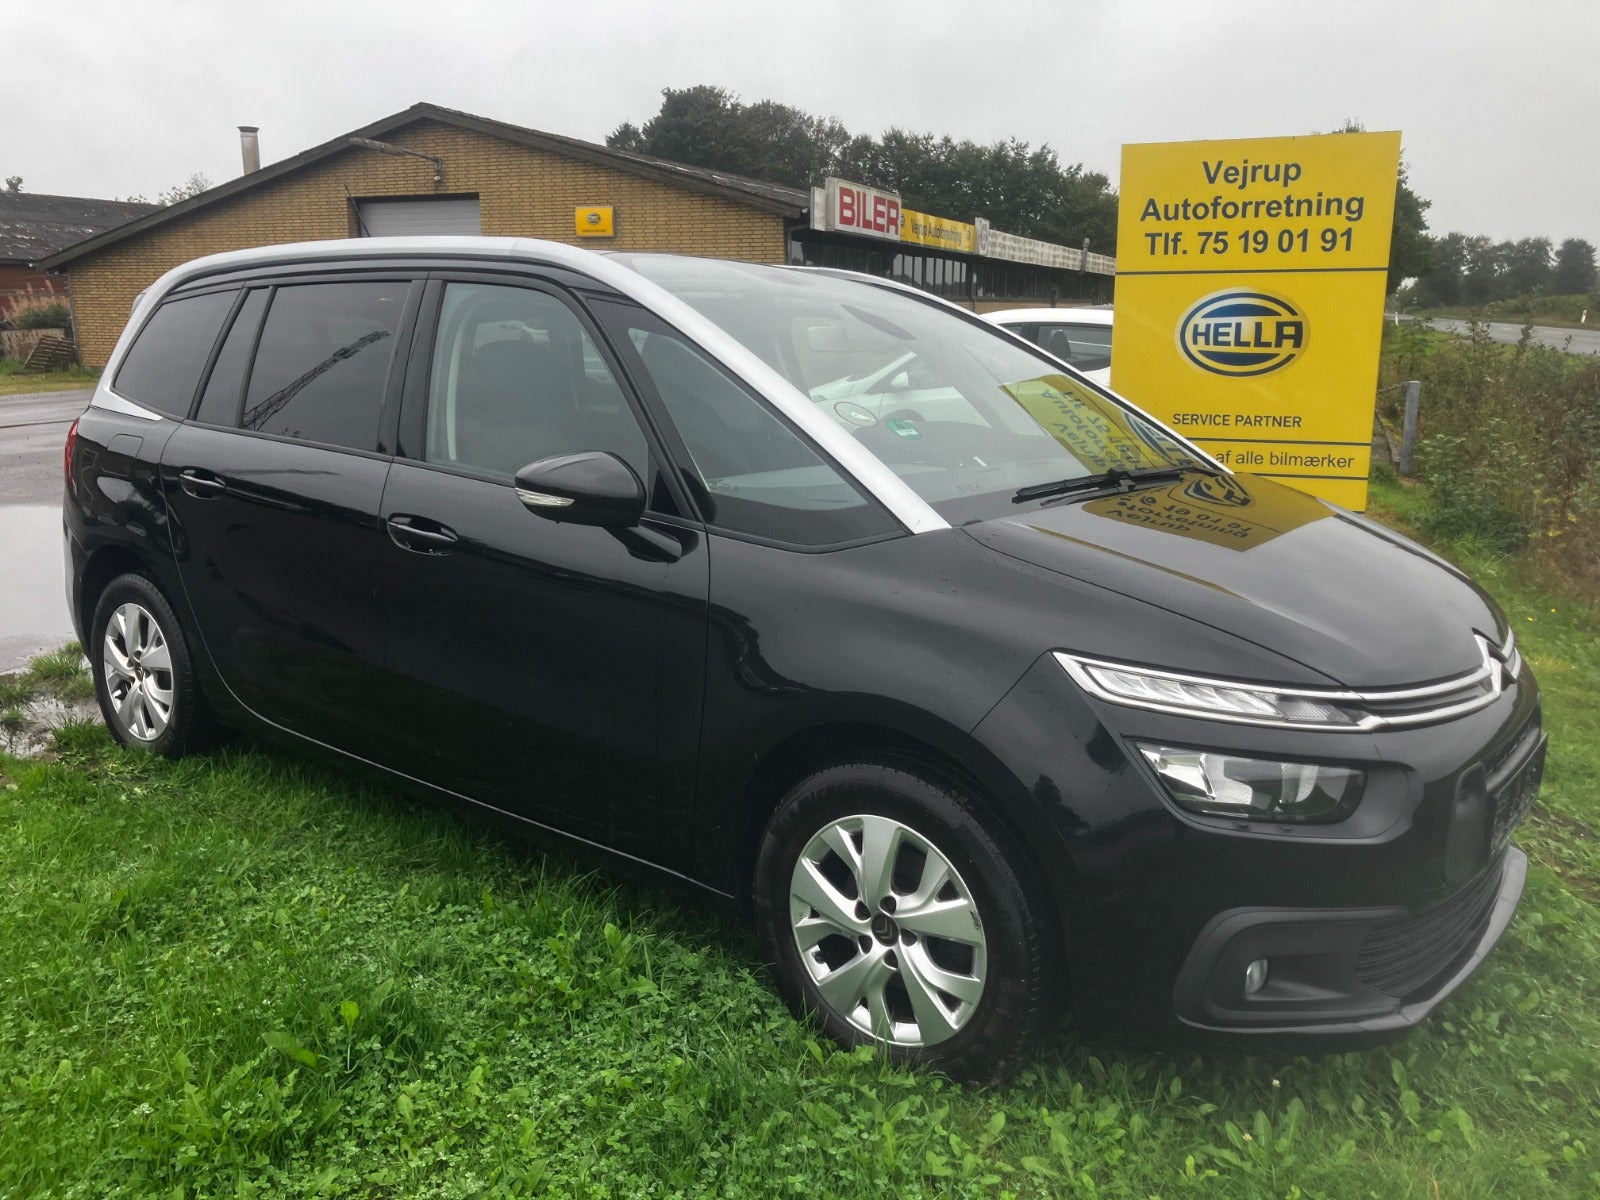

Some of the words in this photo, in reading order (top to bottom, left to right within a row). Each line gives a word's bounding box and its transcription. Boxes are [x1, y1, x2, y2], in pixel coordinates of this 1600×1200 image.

[1202, 159, 1302, 190] Vejrup
[839, 187, 899, 236] BILER
[1140, 192, 1364, 222] Autoforretning
[1144, 231, 1187, 256] Tlf.
[1197, 231, 1228, 255] 75
[1238, 229, 1269, 254] 19
[1278, 228, 1308, 253] 01
[1320, 227, 1353, 252] 91
[1192, 320, 1303, 349] HELLA
[1172, 413, 1231, 426] SERVICE
[1235, 415, 1302, 428] PARTNER
[1235, 451, 1264, 465] alle
[1269, 451, 1354, 468] bilmærker
